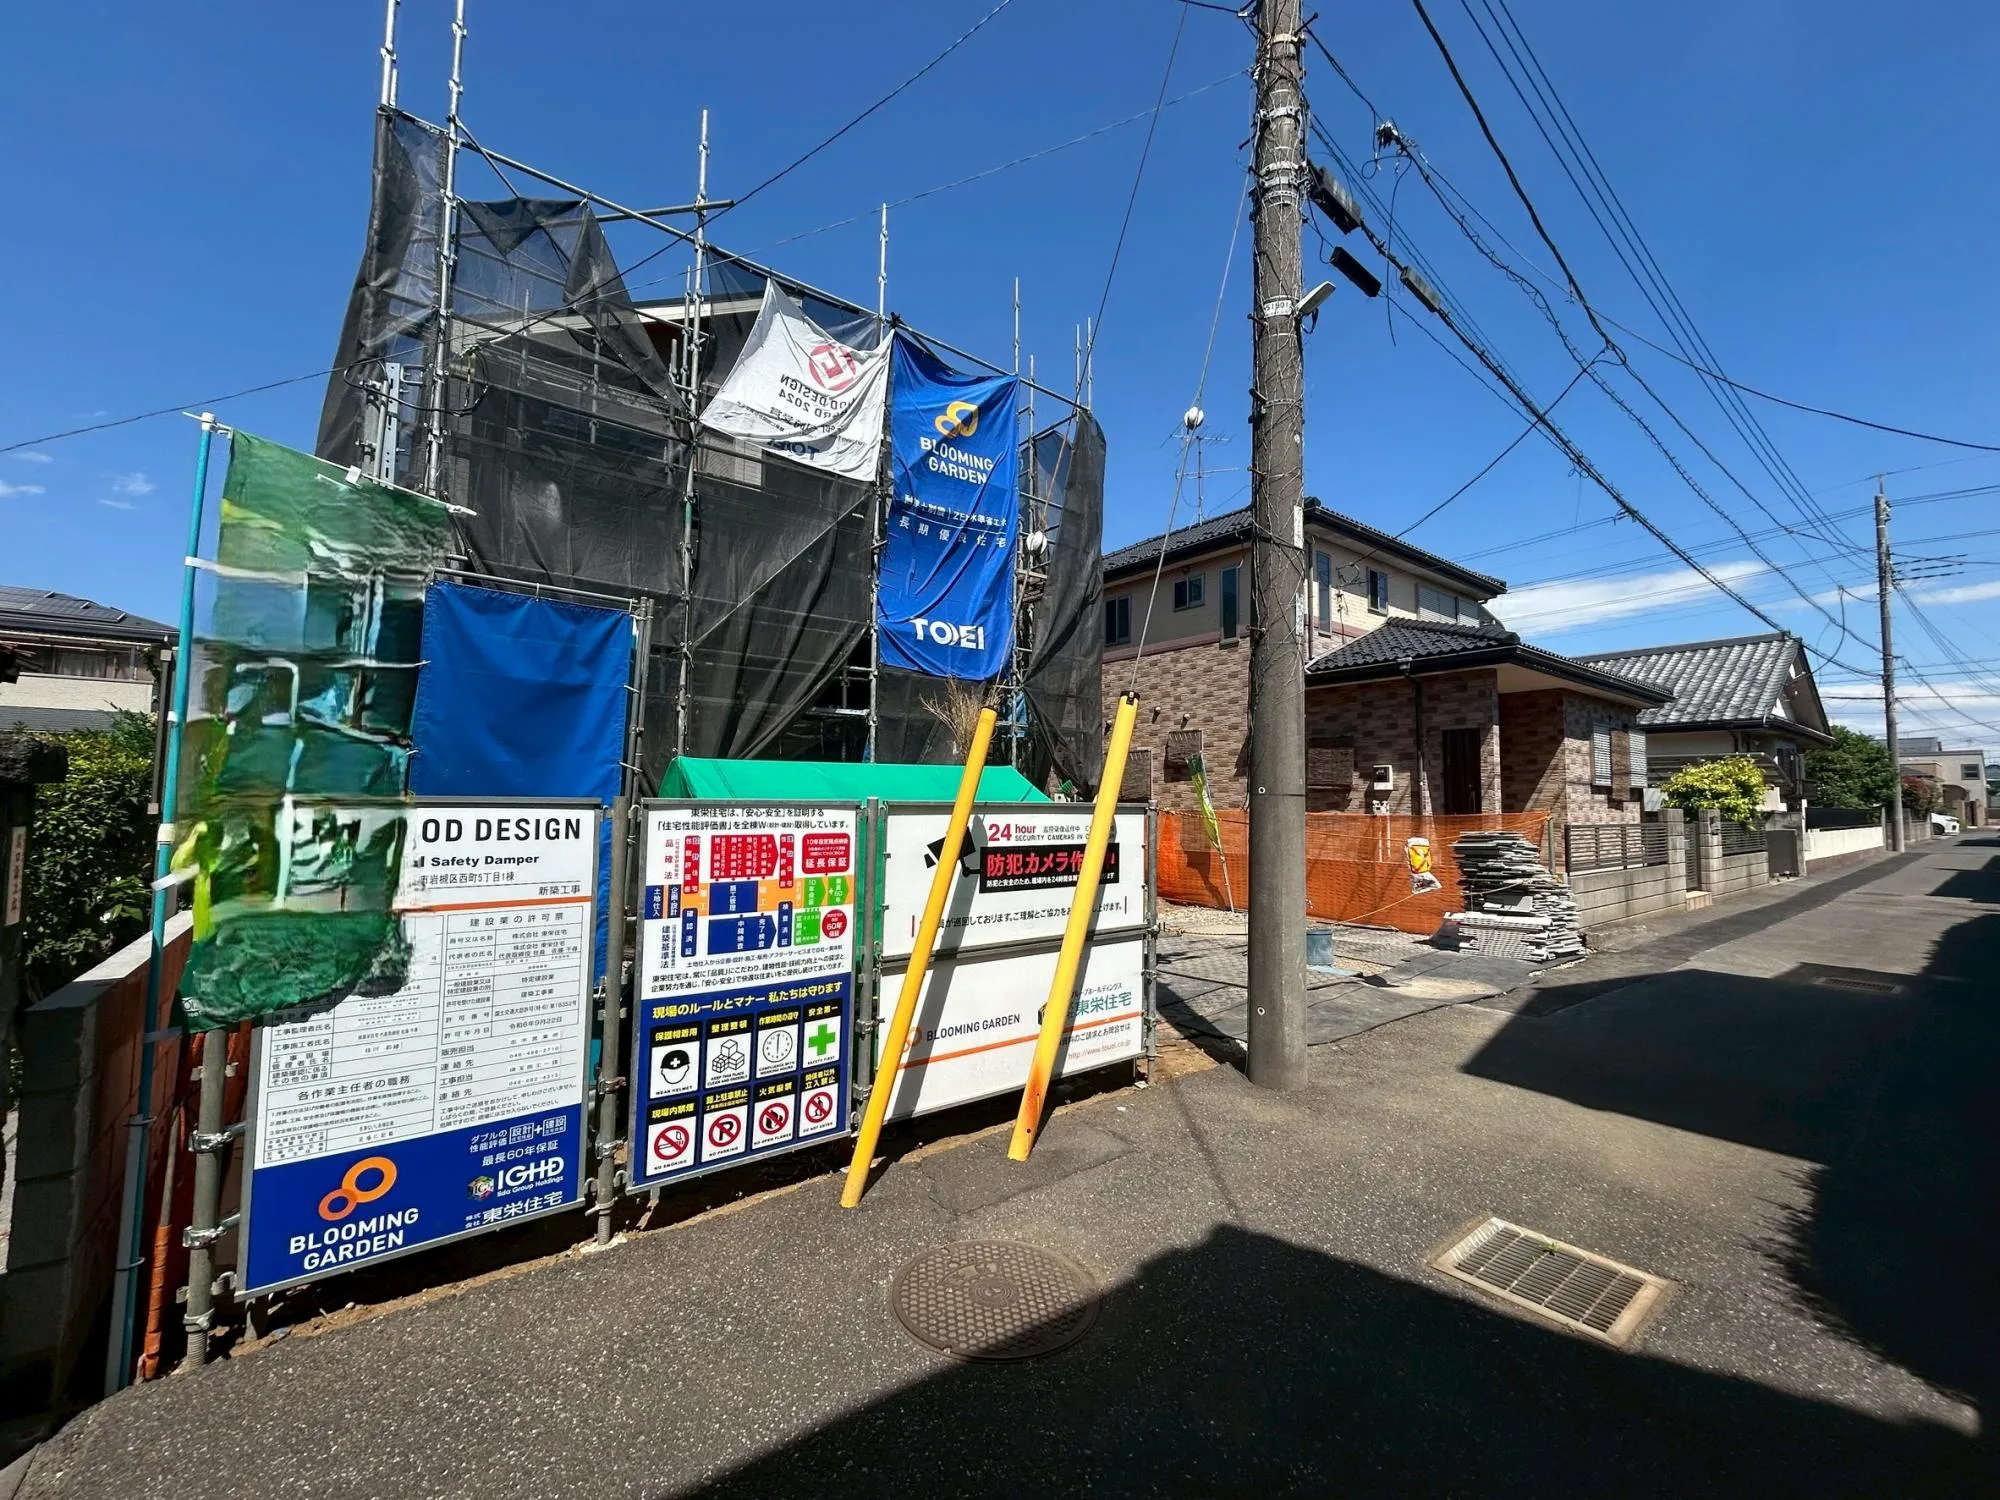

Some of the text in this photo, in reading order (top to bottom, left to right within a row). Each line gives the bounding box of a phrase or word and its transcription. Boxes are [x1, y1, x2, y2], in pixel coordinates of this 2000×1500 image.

[920, 436, 994, 471] BLOOMING
[929, 456, 987, 485] GARDEN
[475, 818, 580, 841] DESIGN
[988, 823, 1037, 842] 24 hour
[431, 855, 480, 868] Safety
[484, 855, 539, 866] Damper
[664, 838, 674, 880] 品確法
[805, 857, 847, 868] 延長保証
[538, 884, 580, 896] 新築工事
[652, 887, 661, 917] 土地仕入
[512, 930, 538, 939] 株式会社
[661, 924, 671, 969] 建築基準法
[652, 981, 843, 1020] 現場のルールとマナー 私たちは守ります
[808, 1004, 839, 1017] 安全第一
[1077, 991, 1132, 1016] 東栄住宅
[711, 1018, 748, 1034] 整理整頓
[926, 1013, 1020, 1042] BLOOMING GARDEN
[440, 1044, 474, 1056] 販売担当
[440, 1059, 474, 1071] 連絡先
[298, 1074, 410, 1101] 各作業主任者の職務
[440, 1073, 473, 1086] 工事担当
[439, 1088, 473, 1101] 連絡先
[469, 1138, 507, 1153] 性能評価
[471, 1129, 507, 1145] ダブルの
[511, 1125, 531, 1137] 設計
[481, 1140, 559, 1167] 最長60年保証
[512, 1183, 534, 1194] Group
[535, 1176, 564, 1188] Holdings
[482, 1190, 563, 1224] 東栄住宅
[289, 1207, 420, 1255] BLOOMING
[303, 1229, 404, 1271] GARDEN
